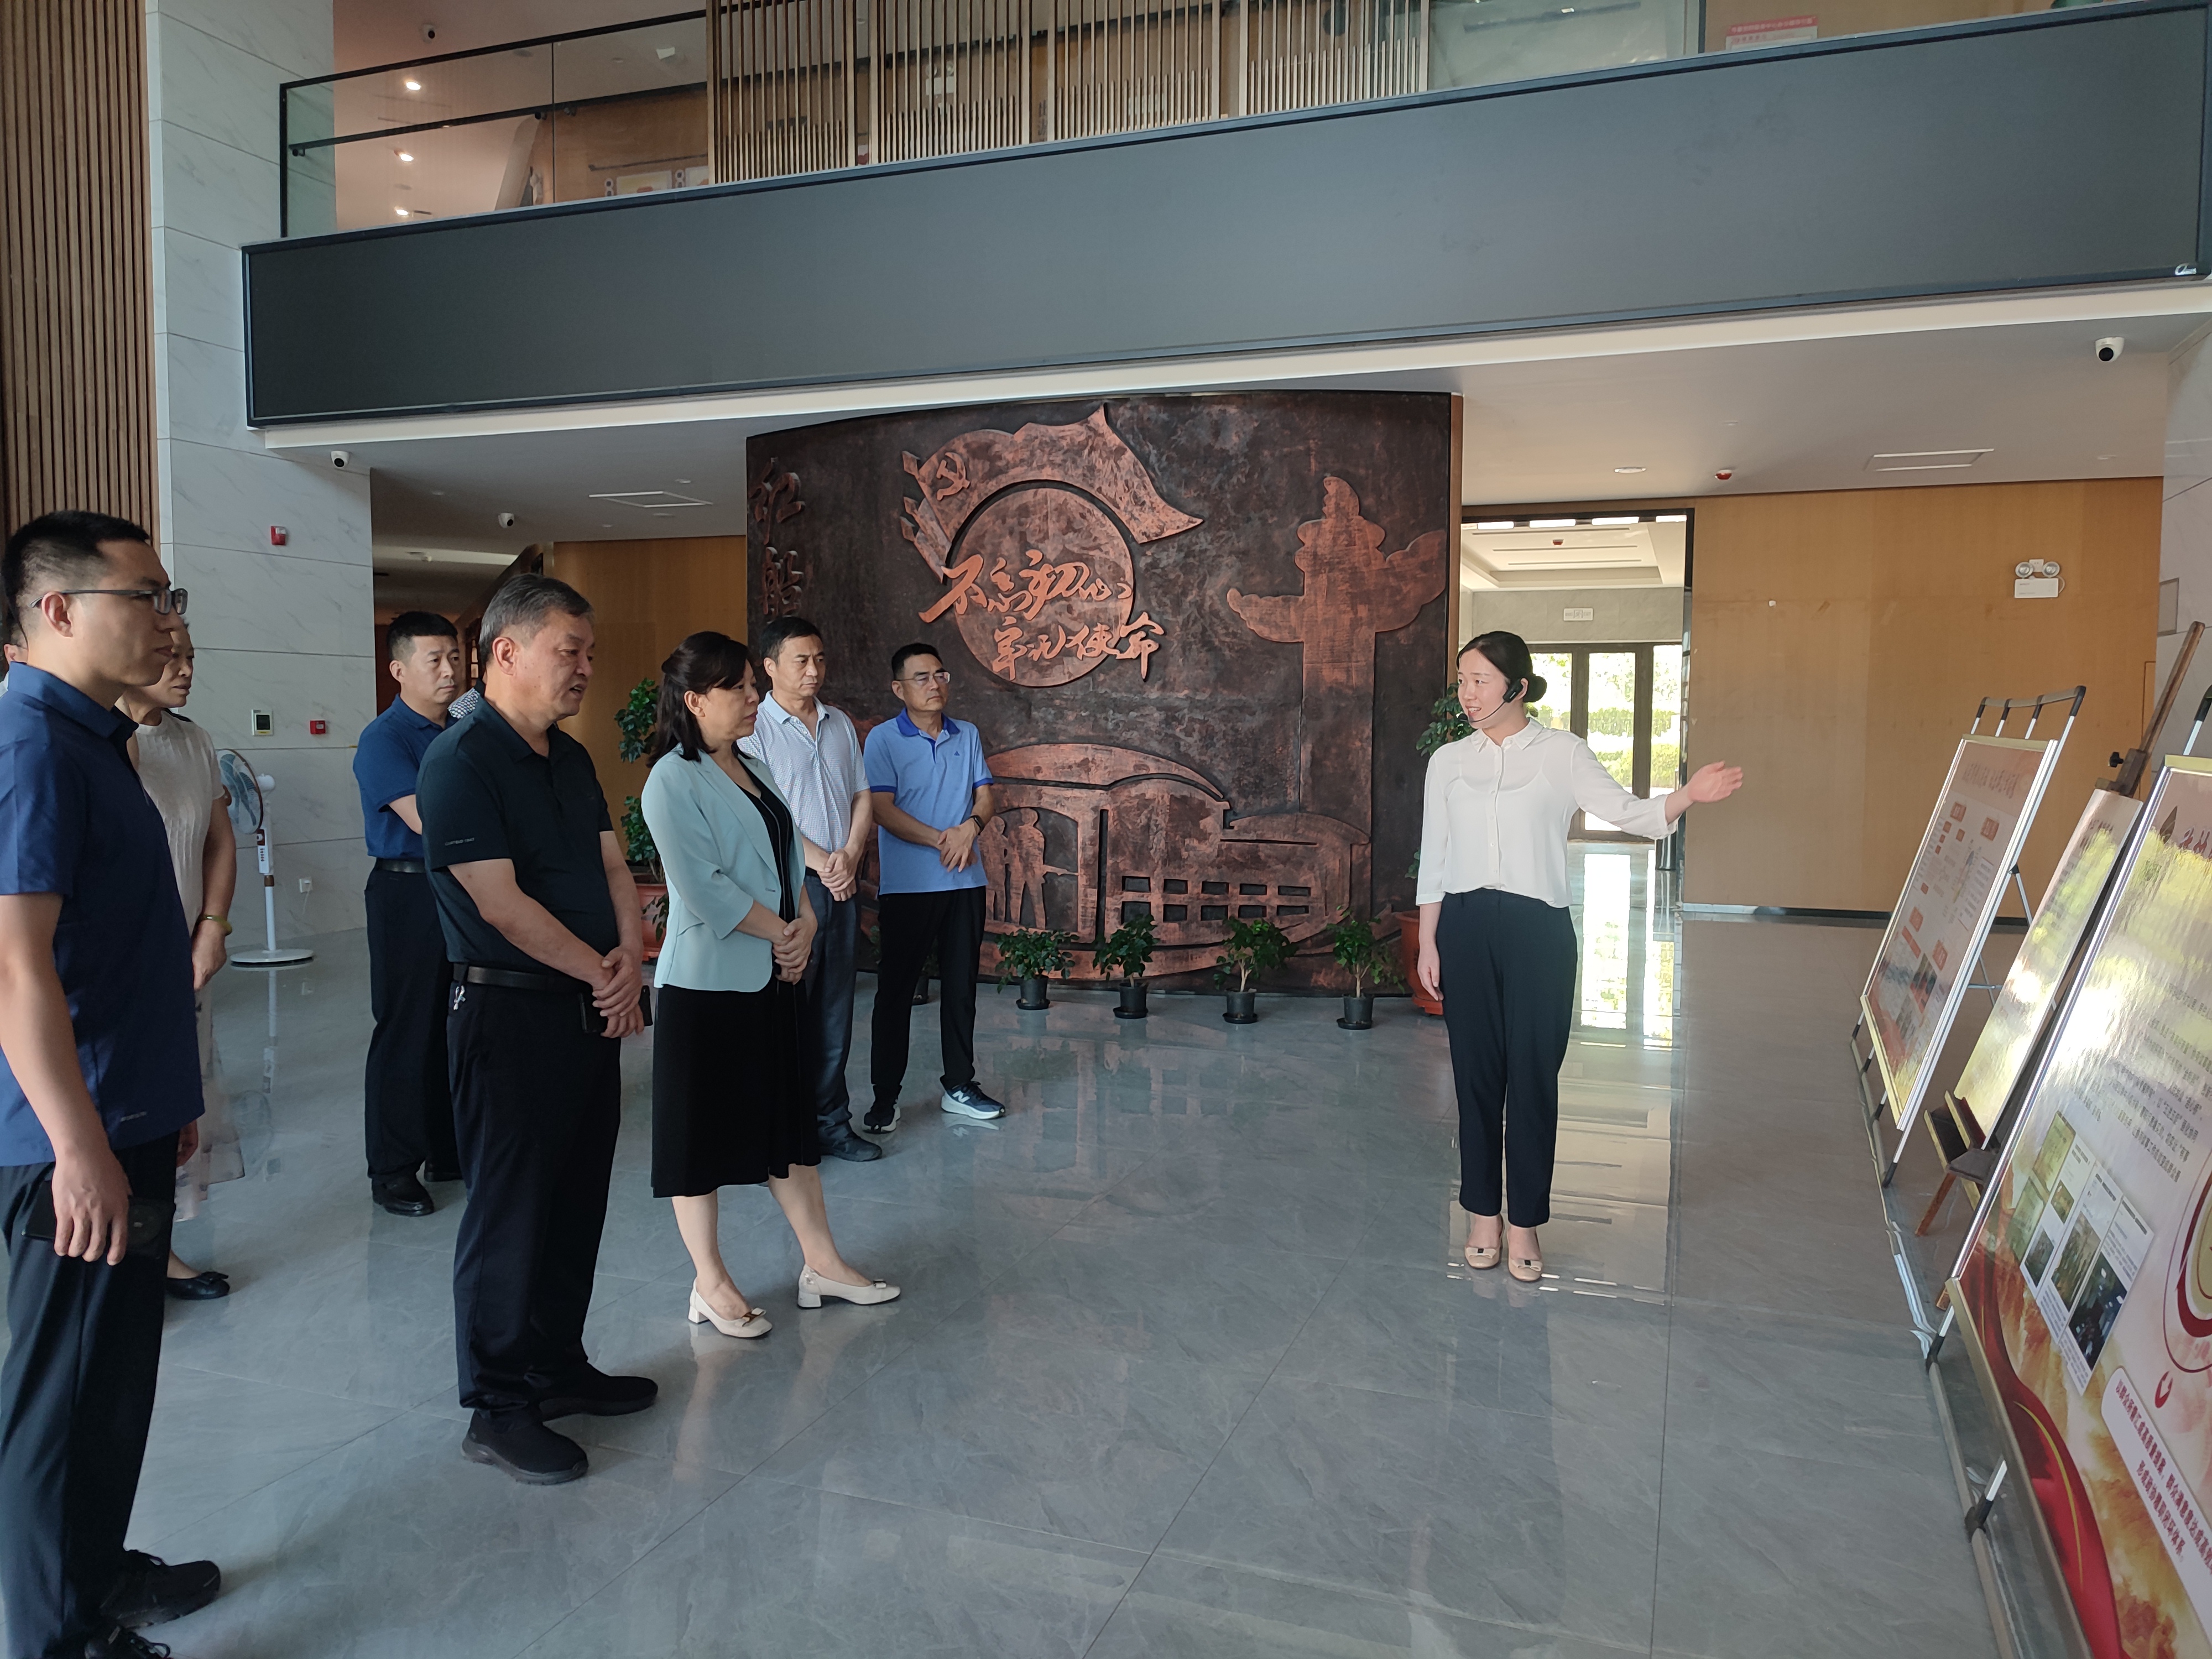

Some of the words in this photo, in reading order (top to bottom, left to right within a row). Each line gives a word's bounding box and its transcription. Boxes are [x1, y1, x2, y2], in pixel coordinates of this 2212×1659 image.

[918, 549, 1133, 623] 不忘初心
[992, 612, 1165, 680] 牢记使命
[952, 1090, 971, 1103] N
